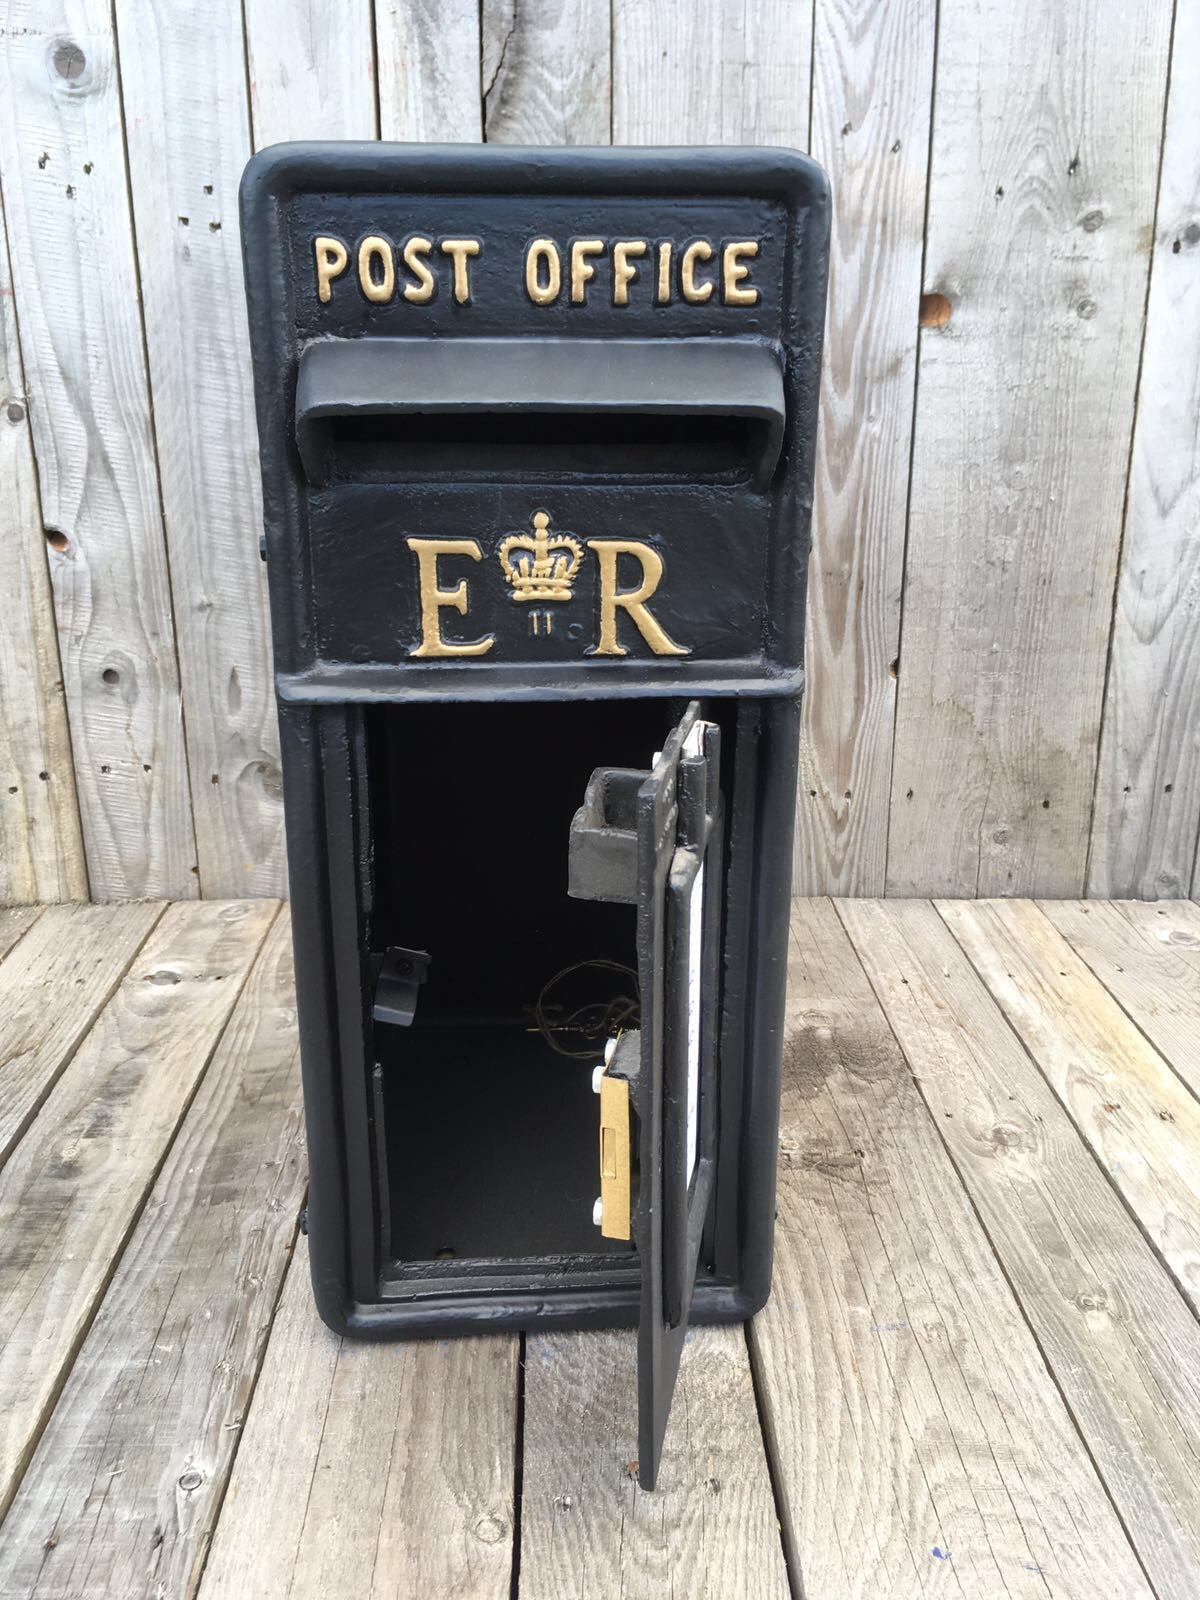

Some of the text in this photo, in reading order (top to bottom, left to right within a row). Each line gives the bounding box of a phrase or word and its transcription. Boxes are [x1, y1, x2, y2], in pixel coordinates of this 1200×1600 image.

[315, 236, 758, 305] POST OFFICE
[407, 538, 691, 656] E R
